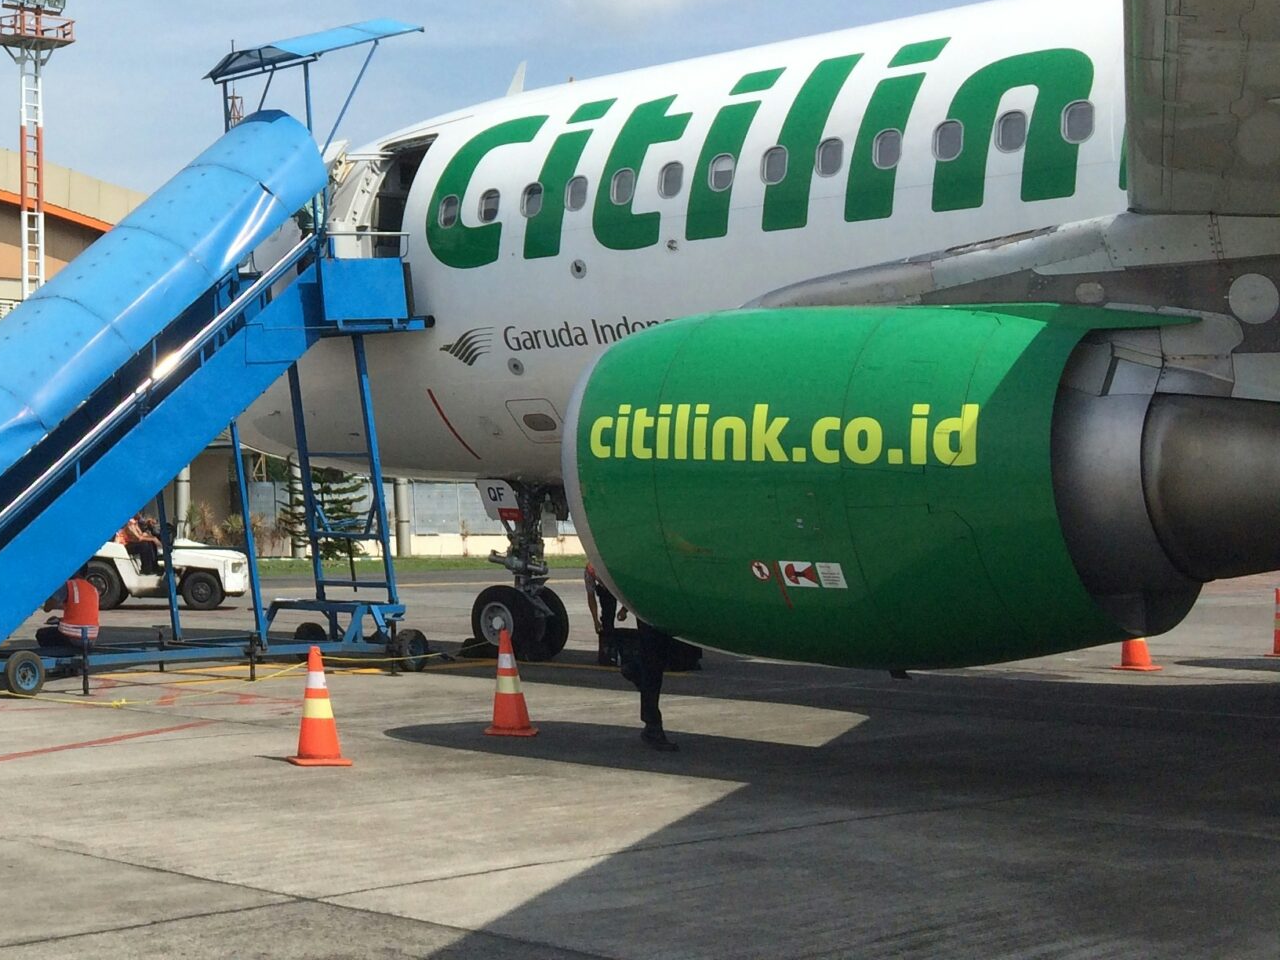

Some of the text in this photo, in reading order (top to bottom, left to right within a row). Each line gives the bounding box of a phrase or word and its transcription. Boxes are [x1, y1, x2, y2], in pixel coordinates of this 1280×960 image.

[426, 36, 1128, 269] citilin
[503, 321, 588, 351] Garuda
[589, 403, 981, 467] citilink.co.id
[487, 486, 505, 502] QF
